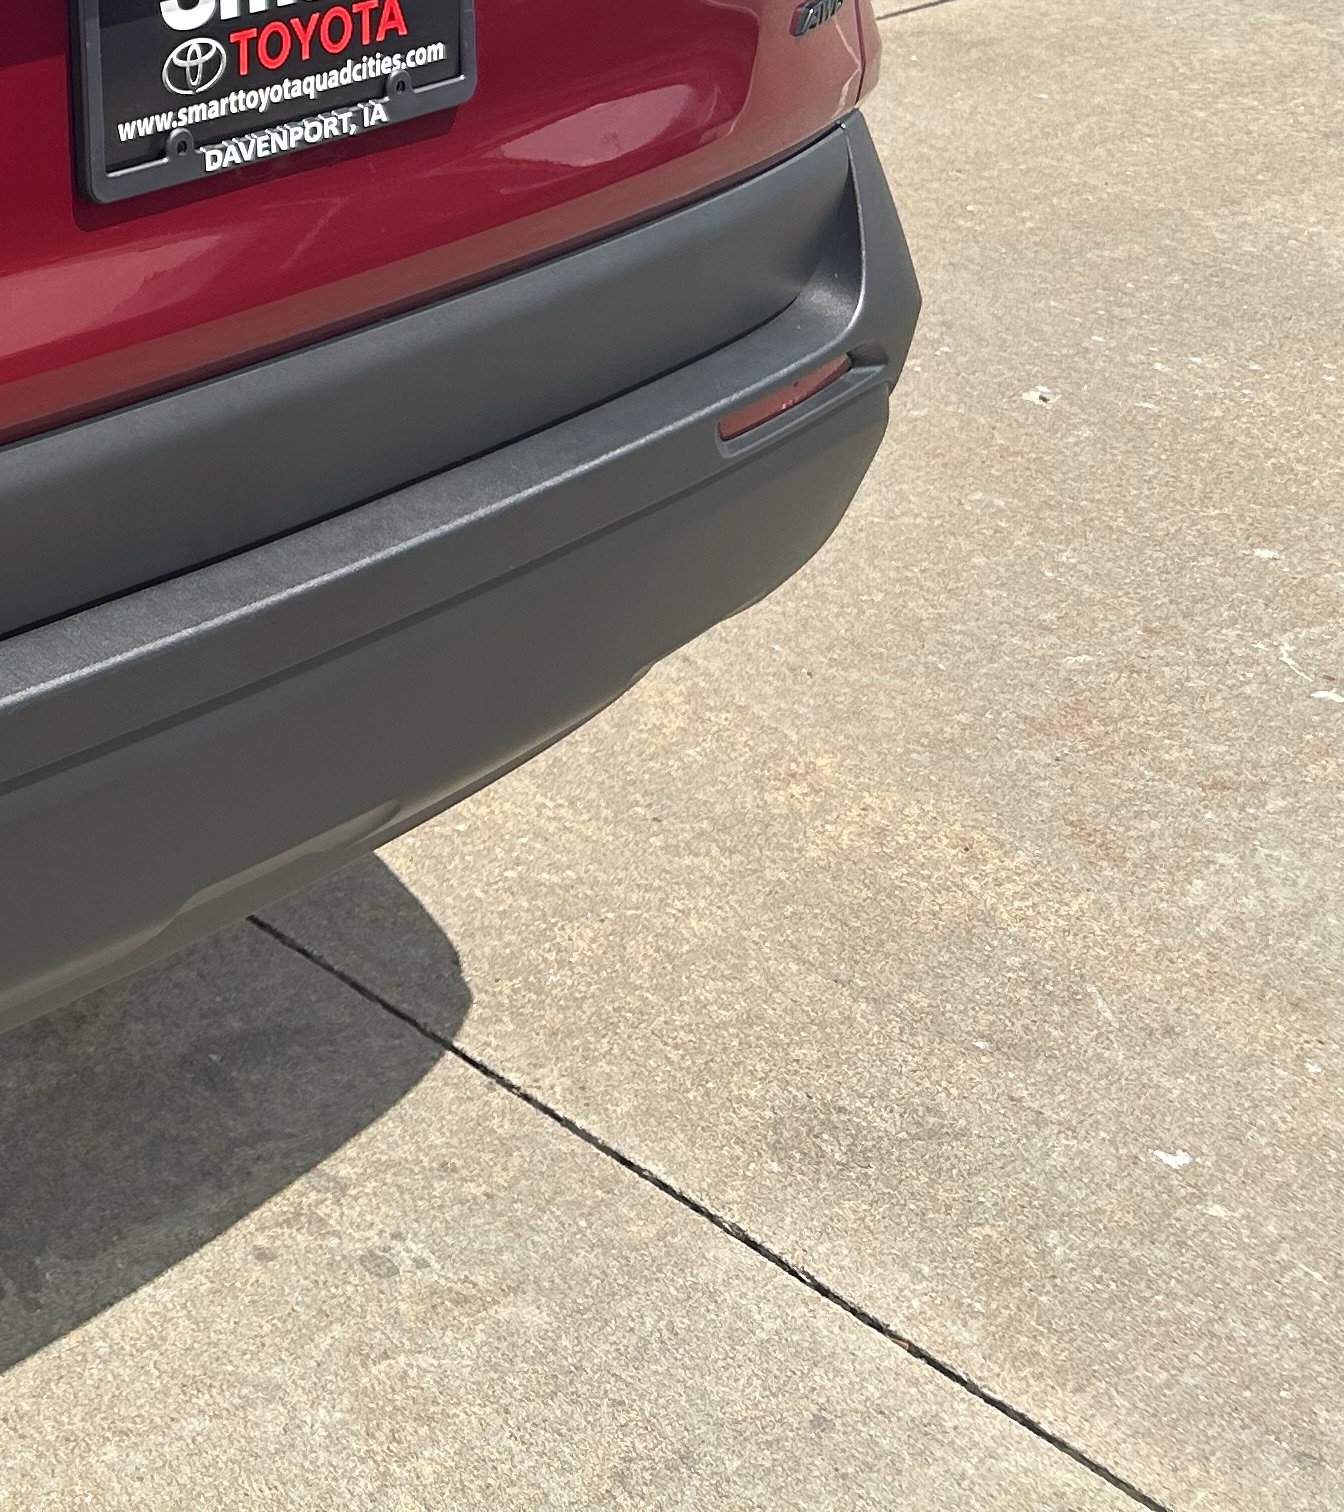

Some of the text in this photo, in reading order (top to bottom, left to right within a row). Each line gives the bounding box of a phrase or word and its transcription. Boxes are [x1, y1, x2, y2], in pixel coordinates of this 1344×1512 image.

[117, 41, 446, 143] www.smarttoyotaquadcities.com
[204, 102, 389, 172] DAVENPORT, IA
